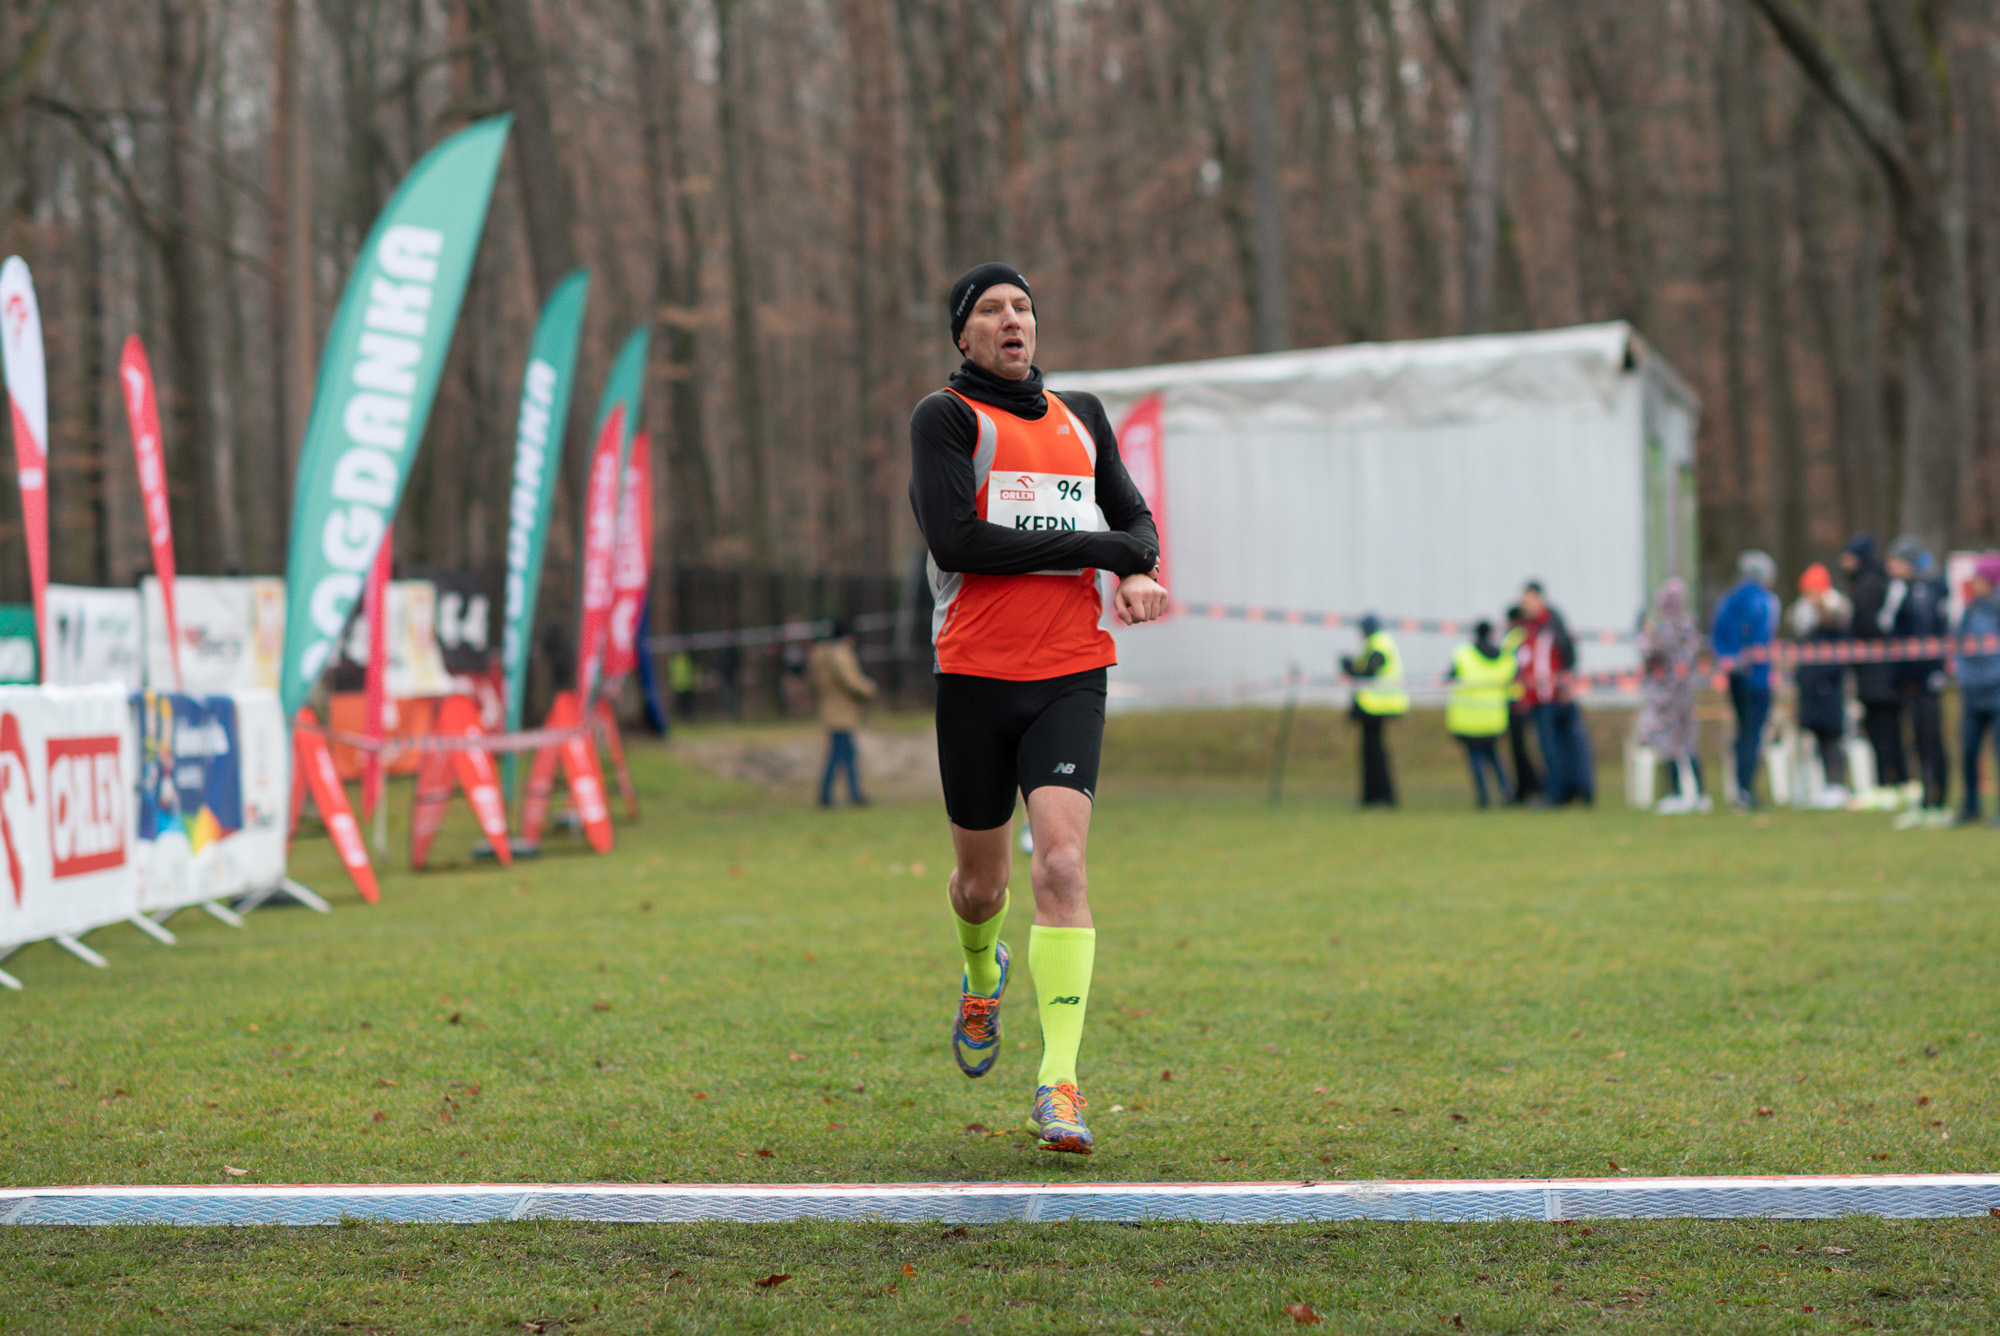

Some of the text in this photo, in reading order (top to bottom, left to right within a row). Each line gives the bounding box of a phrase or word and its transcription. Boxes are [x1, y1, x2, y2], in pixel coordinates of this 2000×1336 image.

[1001, 490, 1034, 500] ORLEN
[1057, 479, 1082, 502] 96
[1052, 761, 1076, 774] NB
